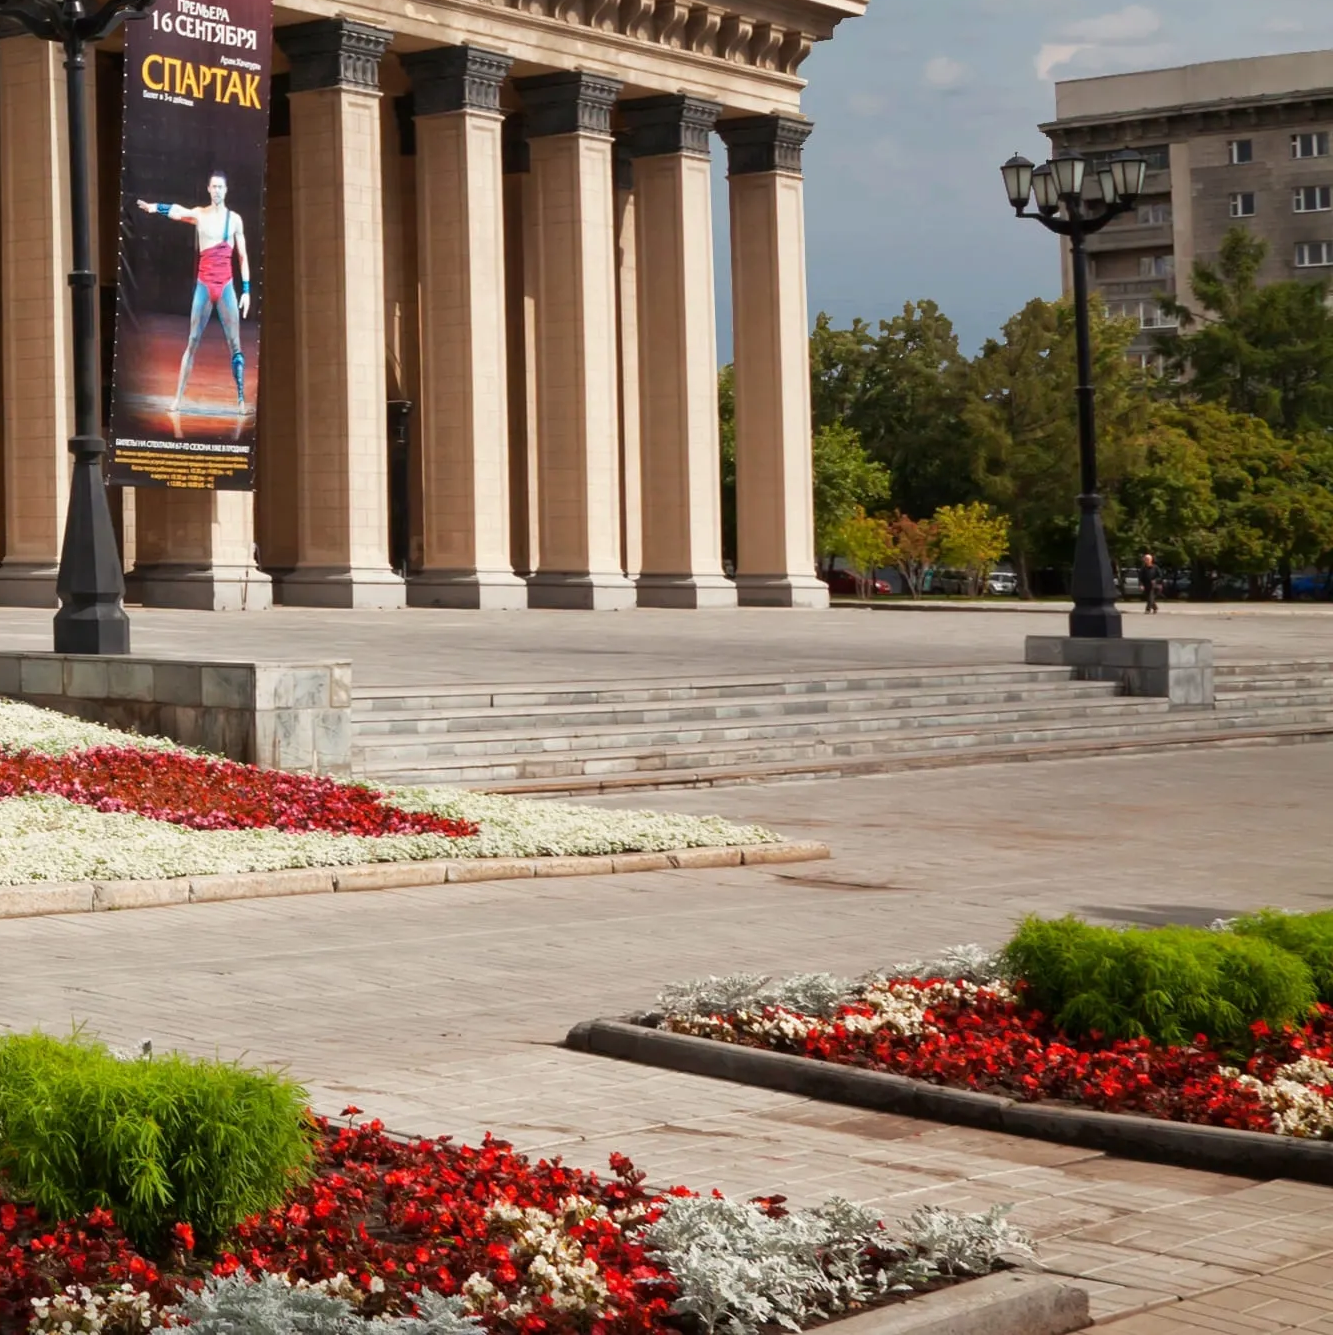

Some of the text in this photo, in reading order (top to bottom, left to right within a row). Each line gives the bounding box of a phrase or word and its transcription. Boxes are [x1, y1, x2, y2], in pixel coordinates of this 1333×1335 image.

[152, 10, 257, 50] 16 СЕНТЯБРЯ
[142, 54, 261, 109] СПАРТАК
